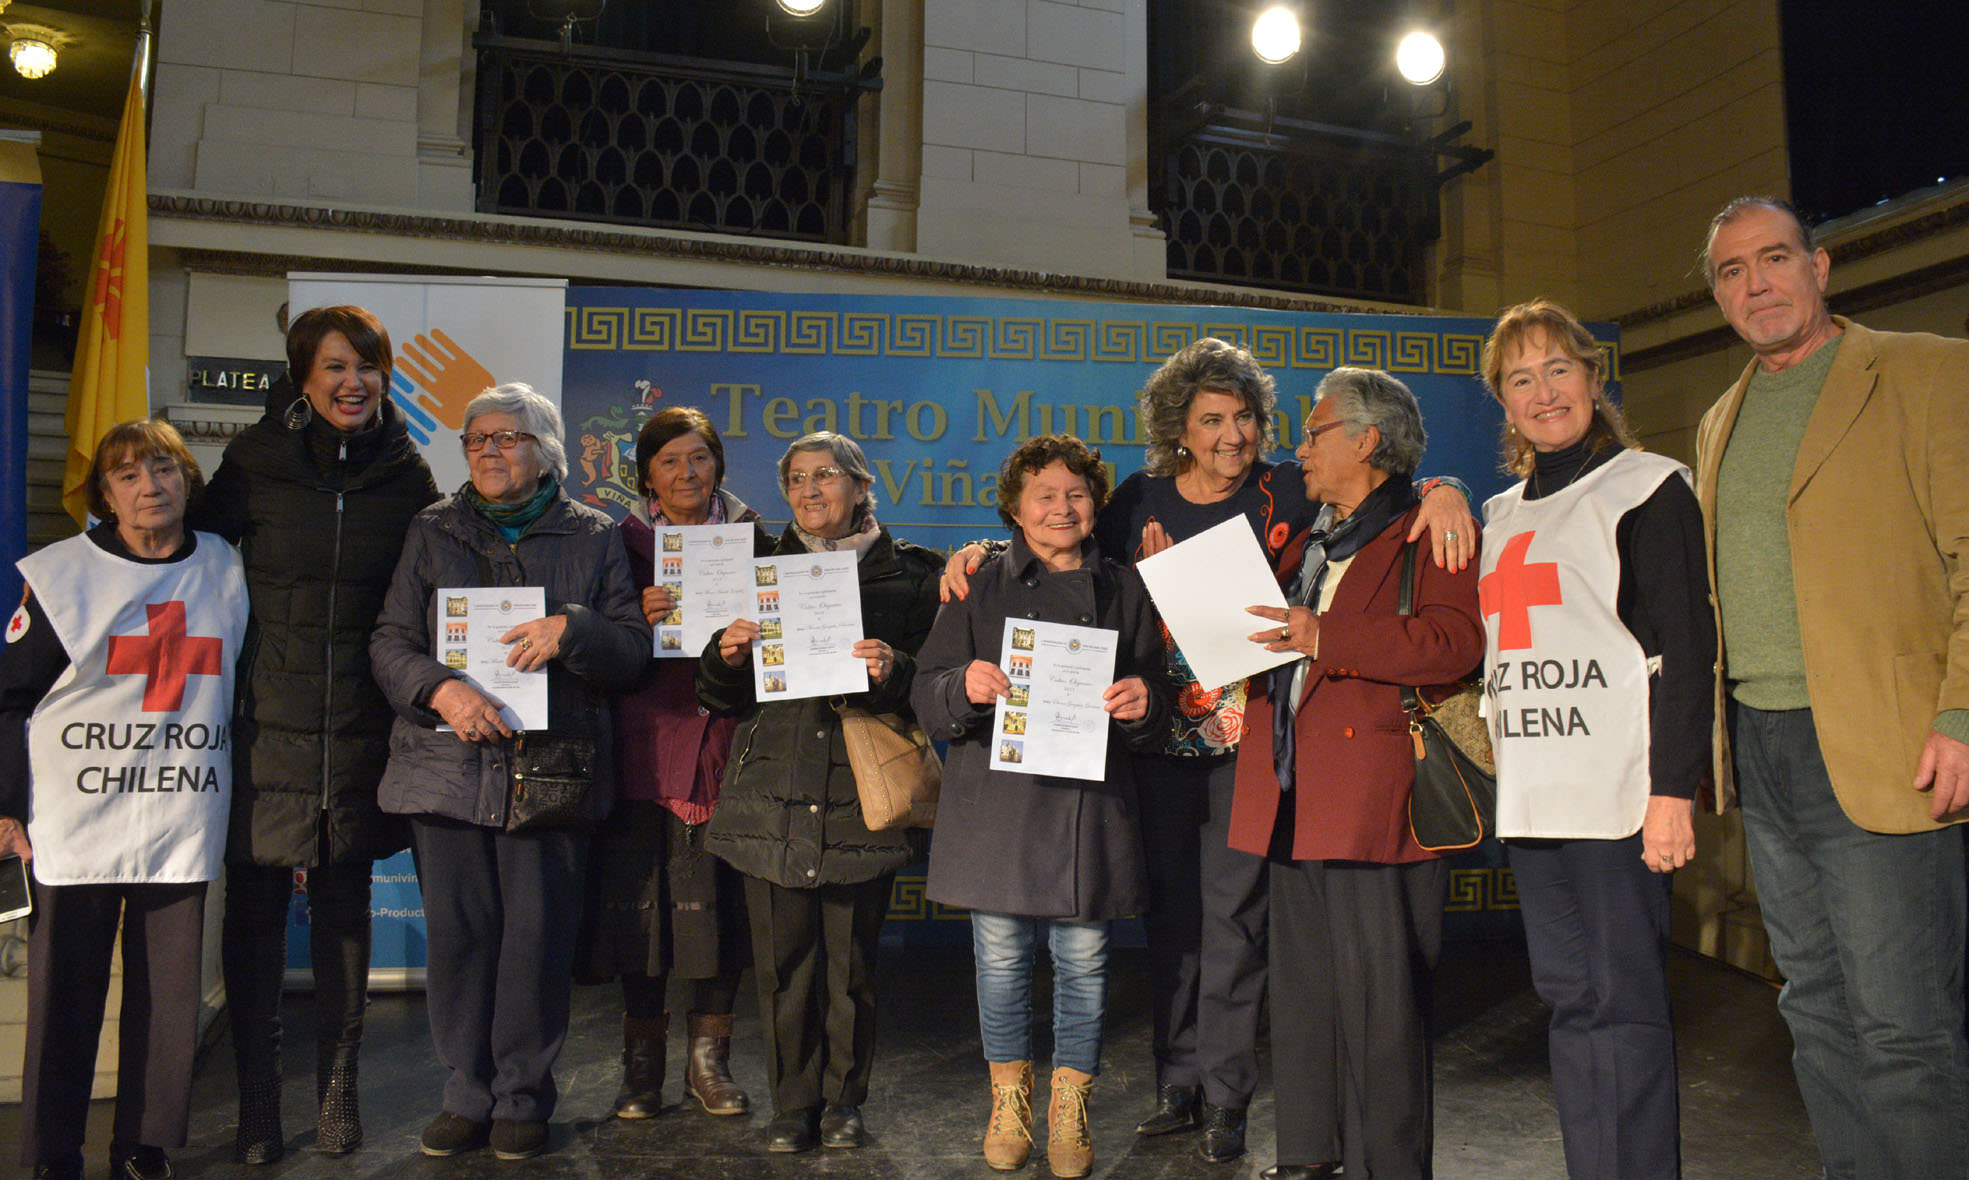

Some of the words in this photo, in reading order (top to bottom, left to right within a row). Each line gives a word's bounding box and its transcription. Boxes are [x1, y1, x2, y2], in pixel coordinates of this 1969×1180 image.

[709, 383, 947, 442] Teatro
[872, 457, 1000, 507] Viña
[1521, 659, 1608, 690] ROJA
[61, 722, 157, 751] CRUZ
[1495, 706, 1591, 739] ILENA
[76, 766, 220, 794] CHILENA
